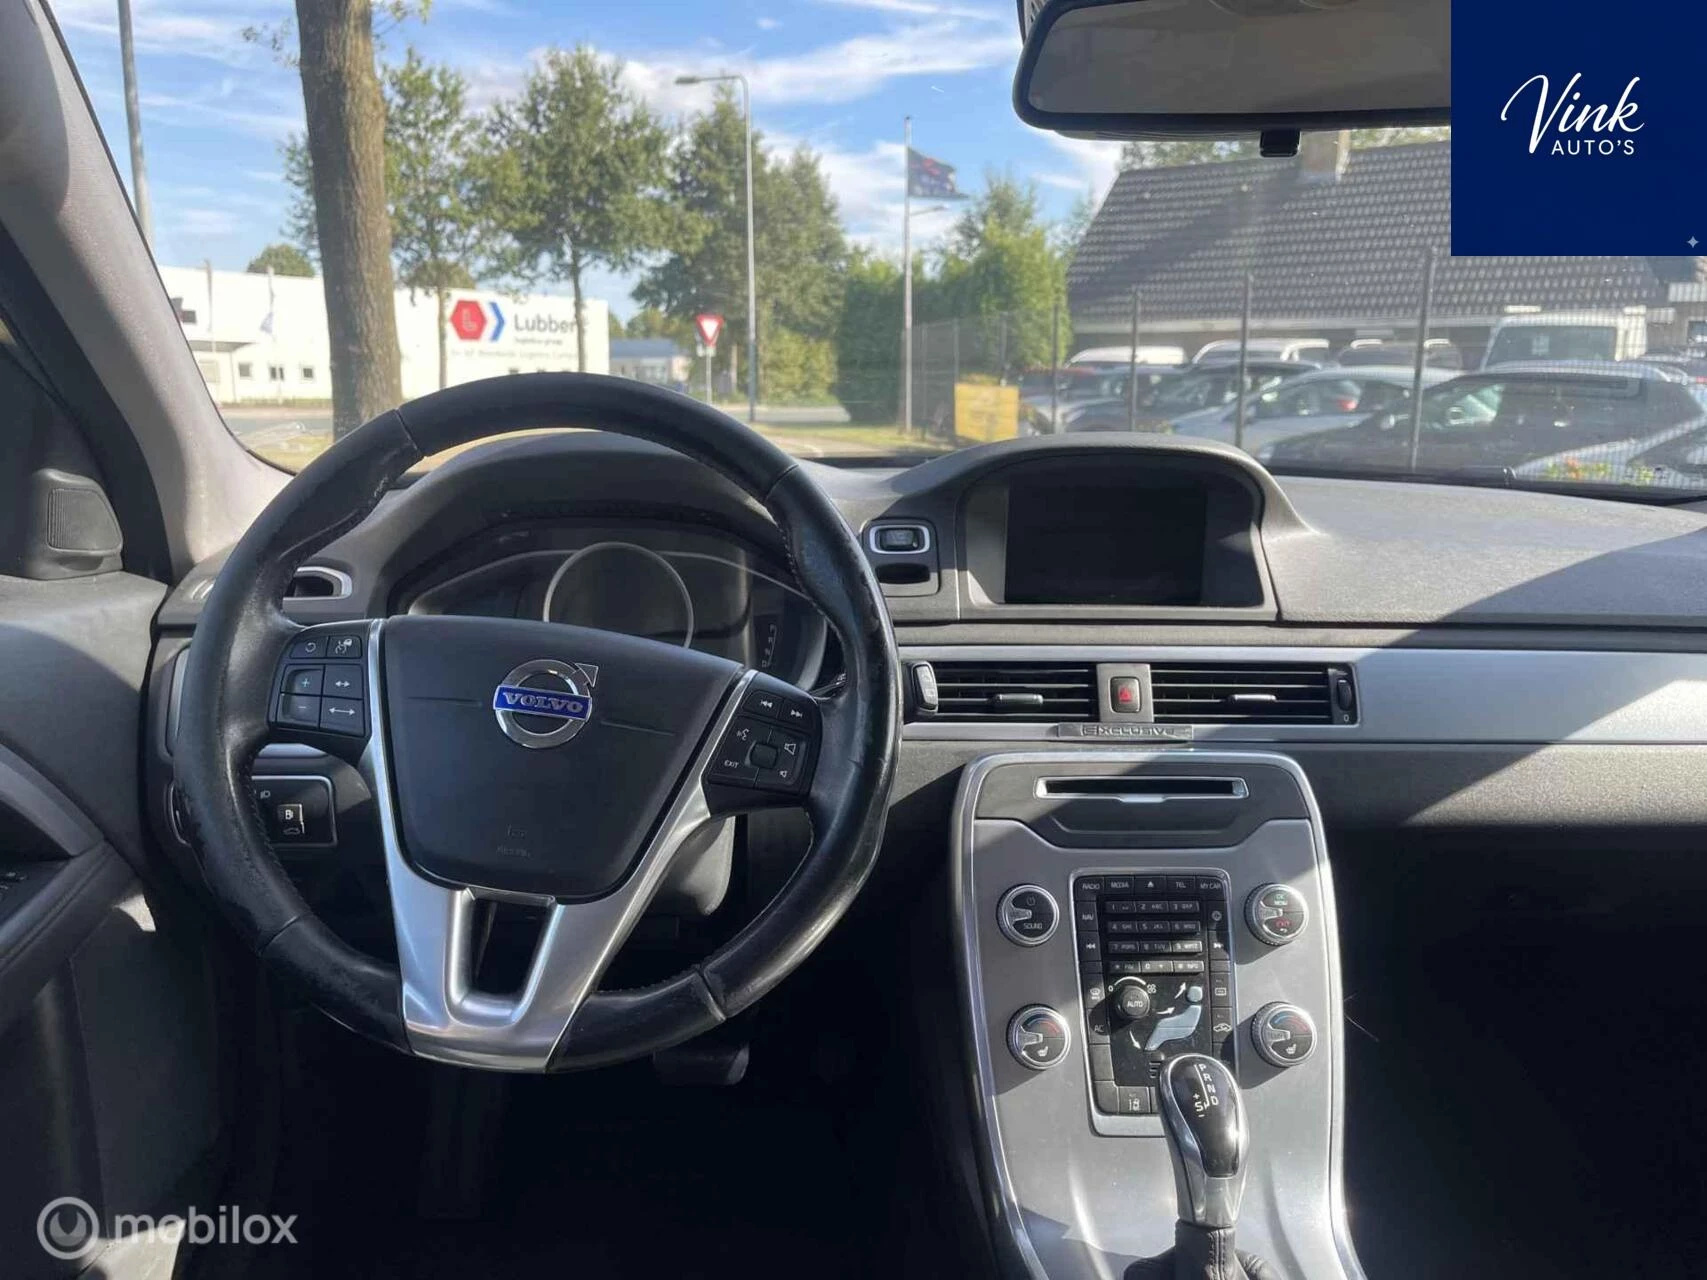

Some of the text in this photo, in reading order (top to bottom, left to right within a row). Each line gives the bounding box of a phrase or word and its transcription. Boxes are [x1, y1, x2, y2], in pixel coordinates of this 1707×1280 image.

[514, 313, 587, 334] Lubber
[502, 691, 584, 714] VOLVO
[723, 759, 739, 769] EXIT
[1081, 882, 1101, 890] RADIO
[1110, 881, 1130, 889] MEDIA
[1175, 881, 1187, 889] TEL
[1200, 882, 1221, 890] MY CAR
[1023, 922, 1043, 930] SOUND
[1126, 1000, 1144, 1008] AUTO
[1094, 1023, 1105, 1033] AC
[1198, 1063, 1207, 1072] P
[1202, 1073, 1213, 1082] R
[1206, 1084, 1216, 1094] N
[1210, 1095, 1219, 1106] D
[1194, 1101, 1204, 1112] S
